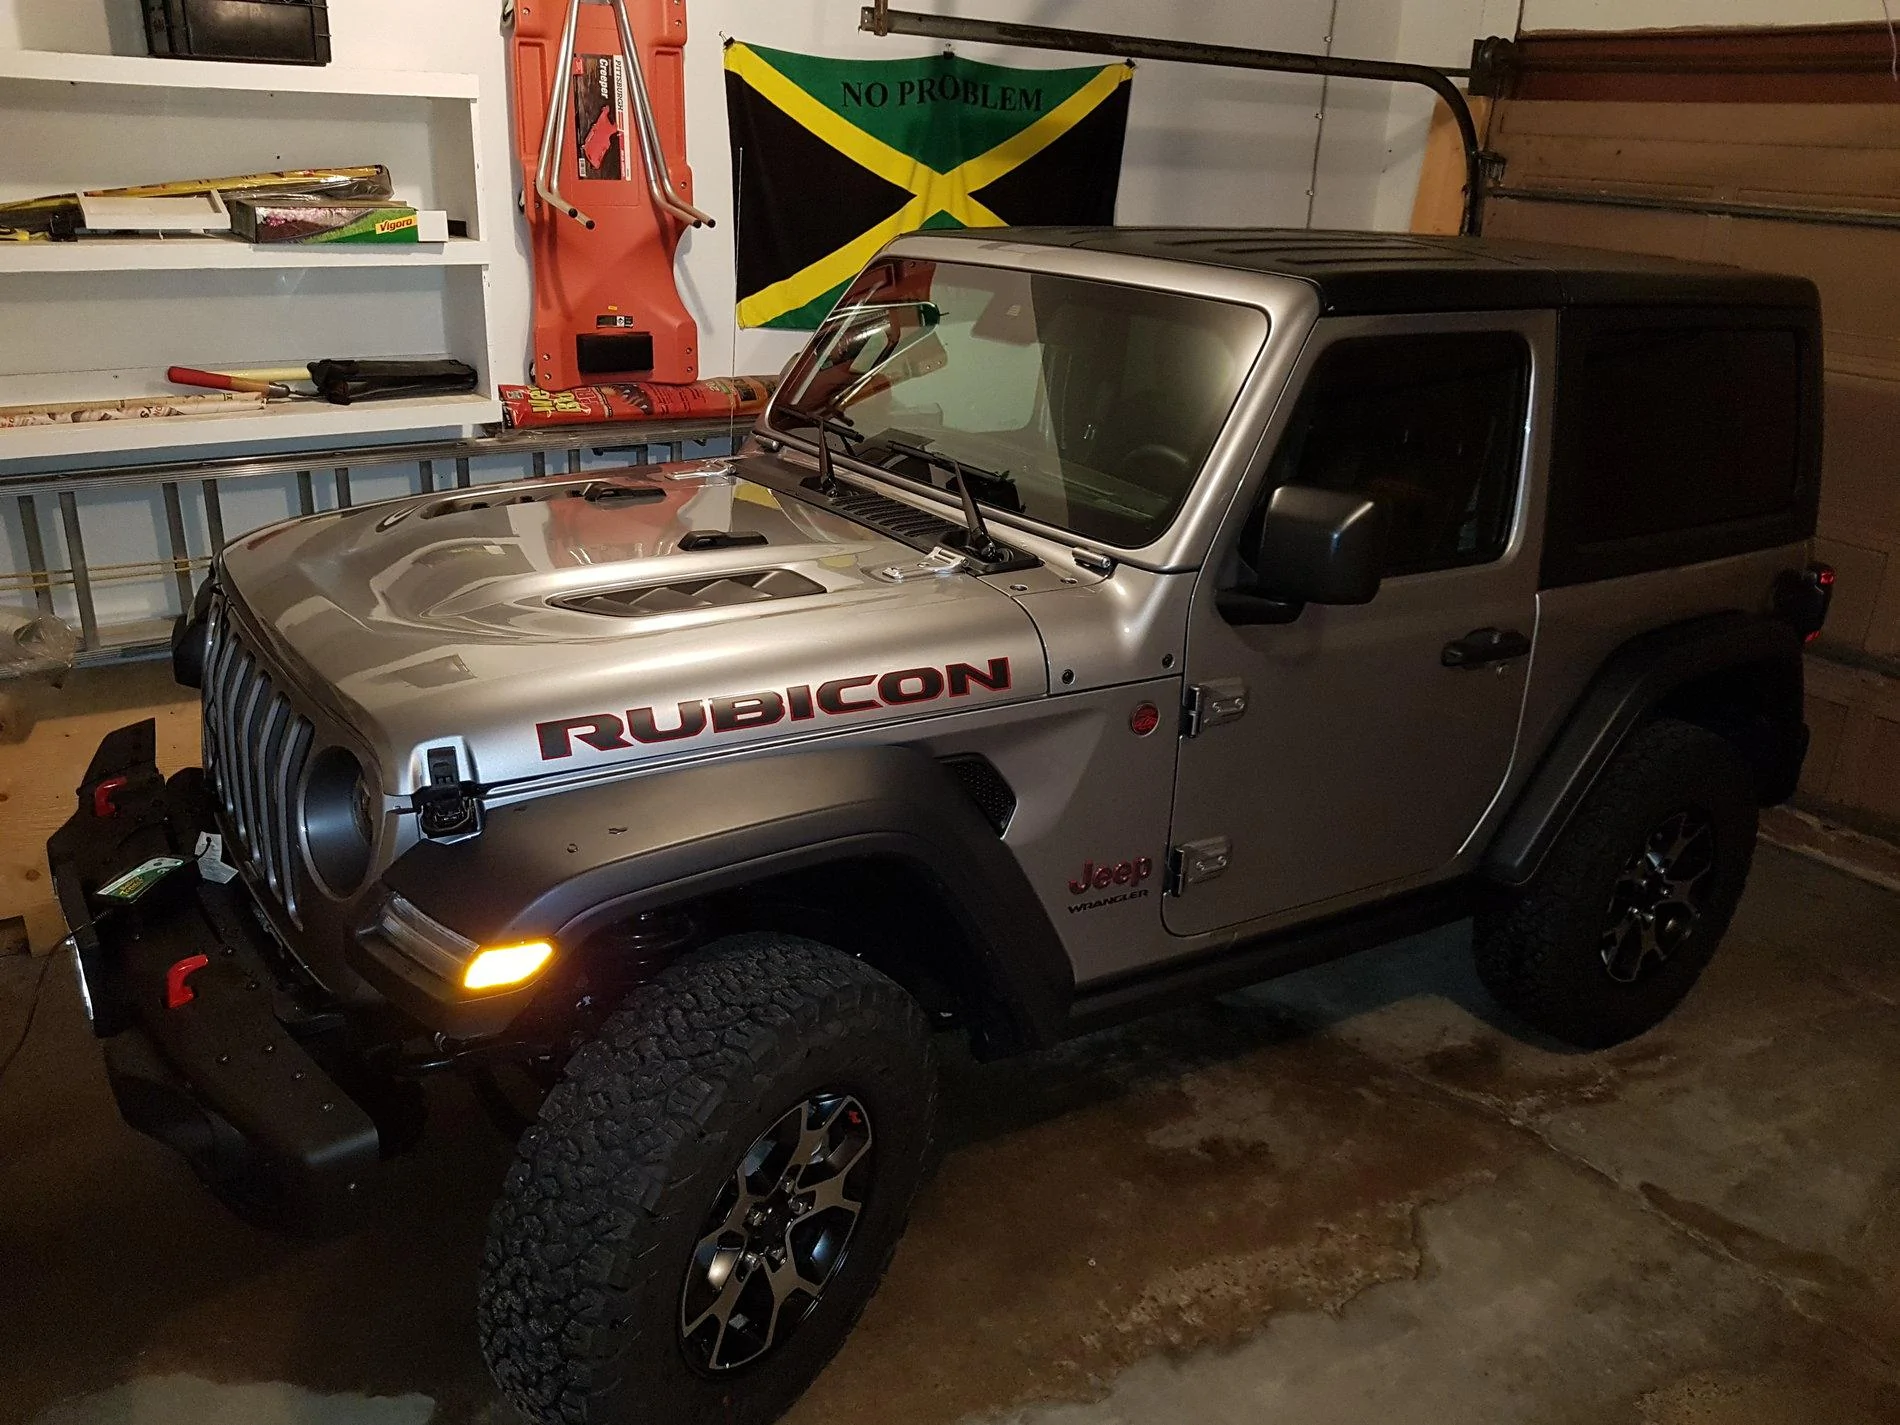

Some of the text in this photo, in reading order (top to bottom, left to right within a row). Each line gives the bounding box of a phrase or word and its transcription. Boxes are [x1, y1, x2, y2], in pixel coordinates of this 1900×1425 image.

[599, 58, 608, 99] Creeper
[615, 59, 624, 111] PITTSBURGH
[842, 75, 1043, 111] NO PROBLEM
[380, 218, 412, 231] Vigoro
[536, 656, 1012, 760] RUBICON
[1068, 857, 1152, 895] Jeep
[1067, 889, 1149, 914] WRANGLER
